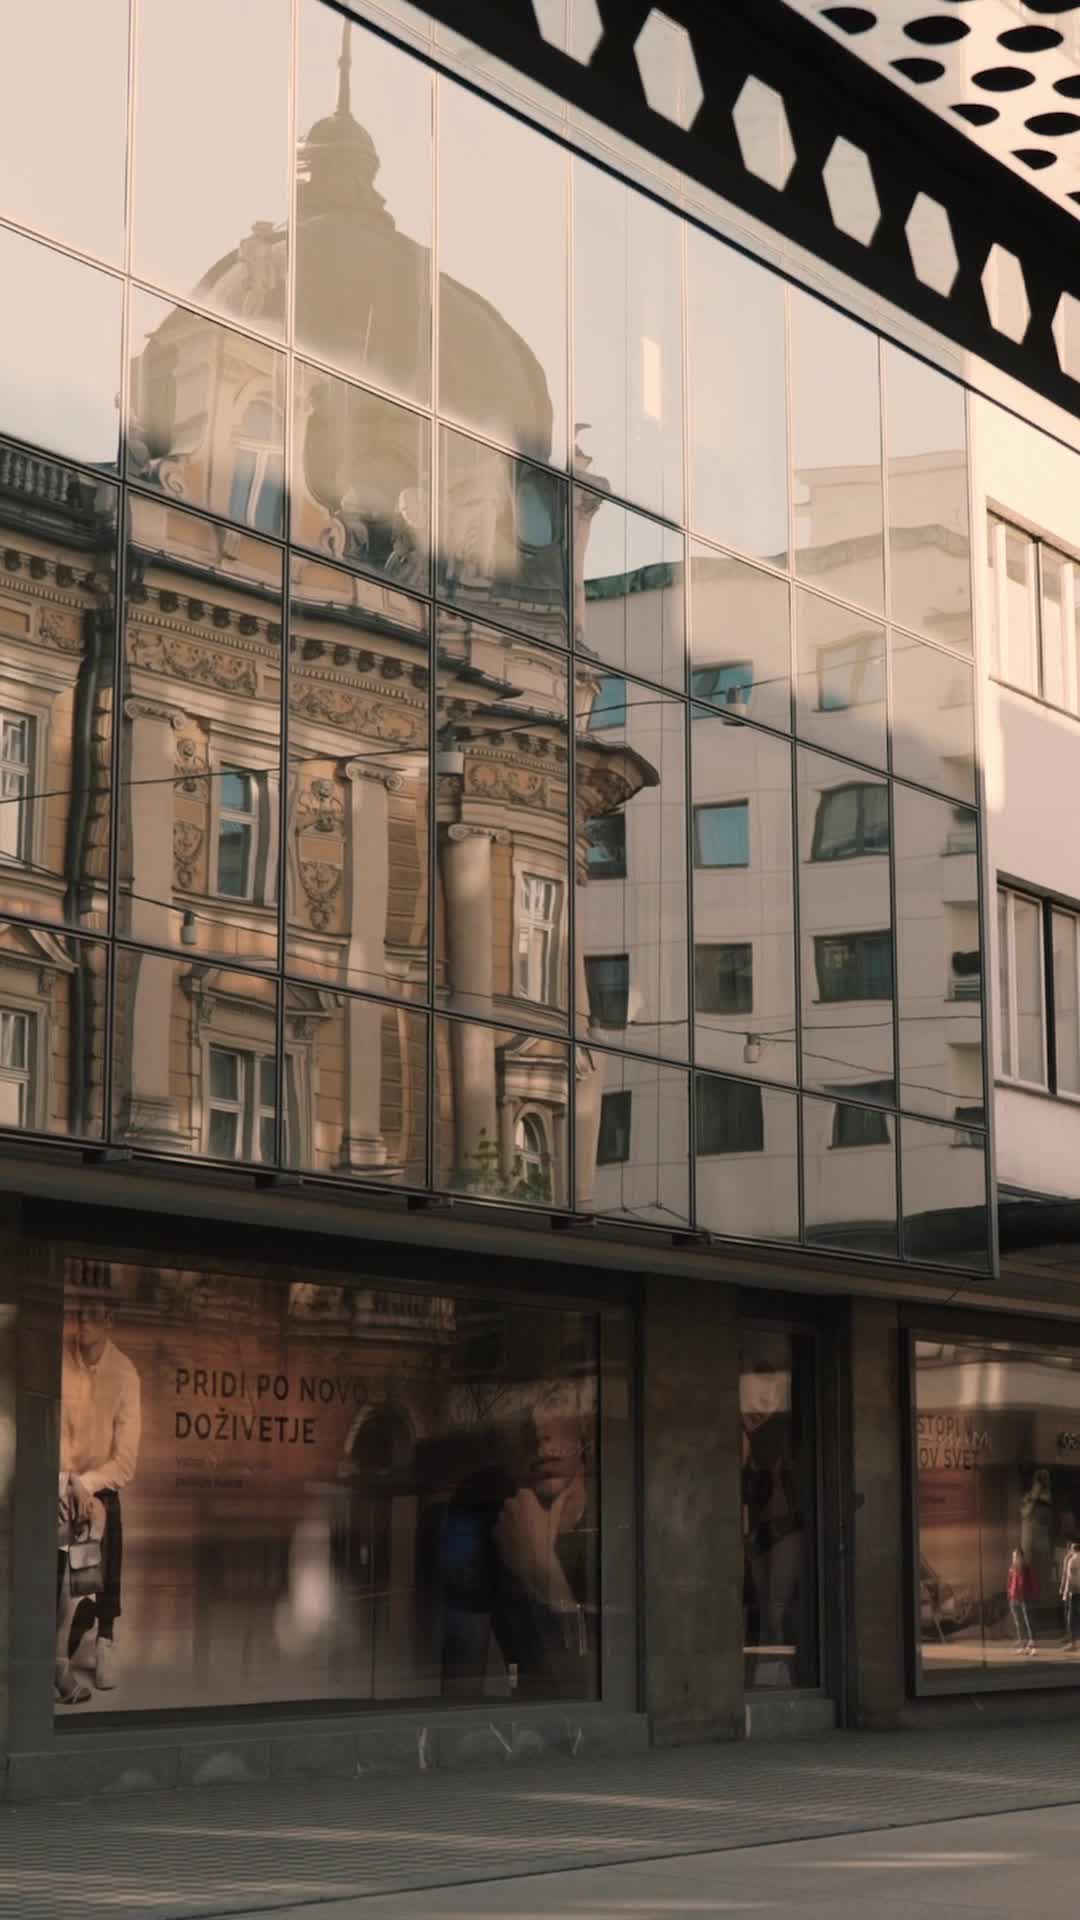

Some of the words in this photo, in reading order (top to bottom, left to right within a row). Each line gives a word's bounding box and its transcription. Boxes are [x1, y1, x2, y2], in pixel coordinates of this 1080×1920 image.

[175, 1367, 245, 1399] PRIDI
[257, 1373, 289, 1401] PO
[299, 1376, 368, 1405] NOVO
[175, 1407, 316, 1444] DOŽIVETJE
[918, 1447, 939, 1469] OV
